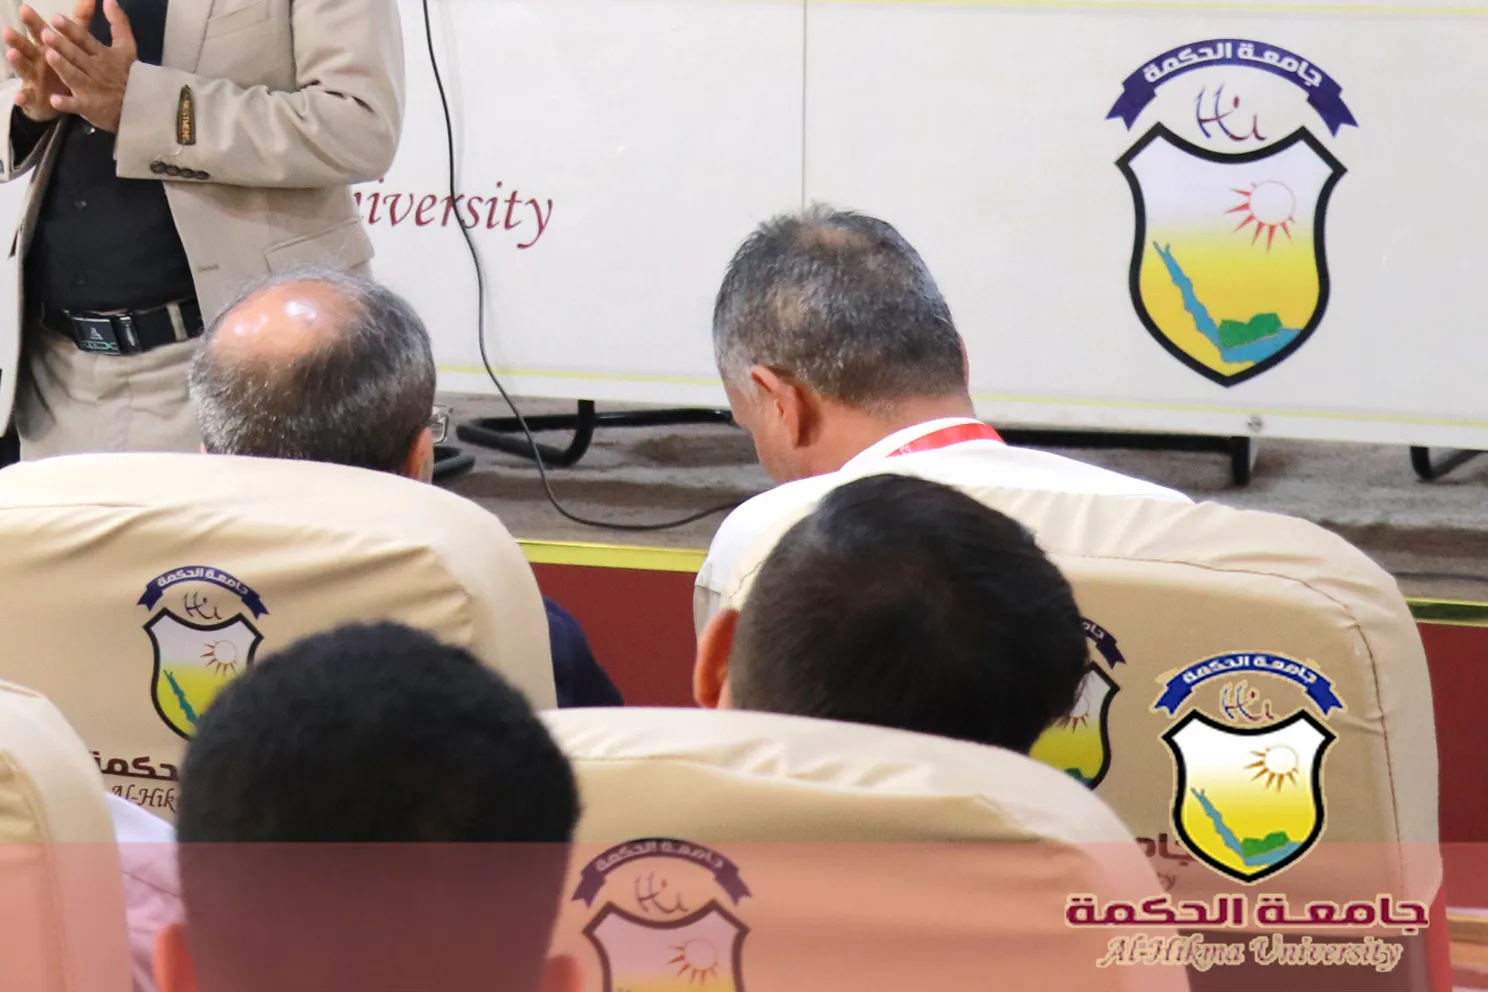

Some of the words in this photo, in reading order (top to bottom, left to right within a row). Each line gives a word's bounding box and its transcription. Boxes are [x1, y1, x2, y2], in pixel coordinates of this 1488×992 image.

[1143, 42, 1232, 83] الحكمة
[1237, 42, 1323, 87] جامعة
[353, 177, 553, 249] iversity
[157, 567, 205, 588] الحكمة
[205, 568, 249, 595] جامعة
[112, 784, 177, 813] Al-Hik
